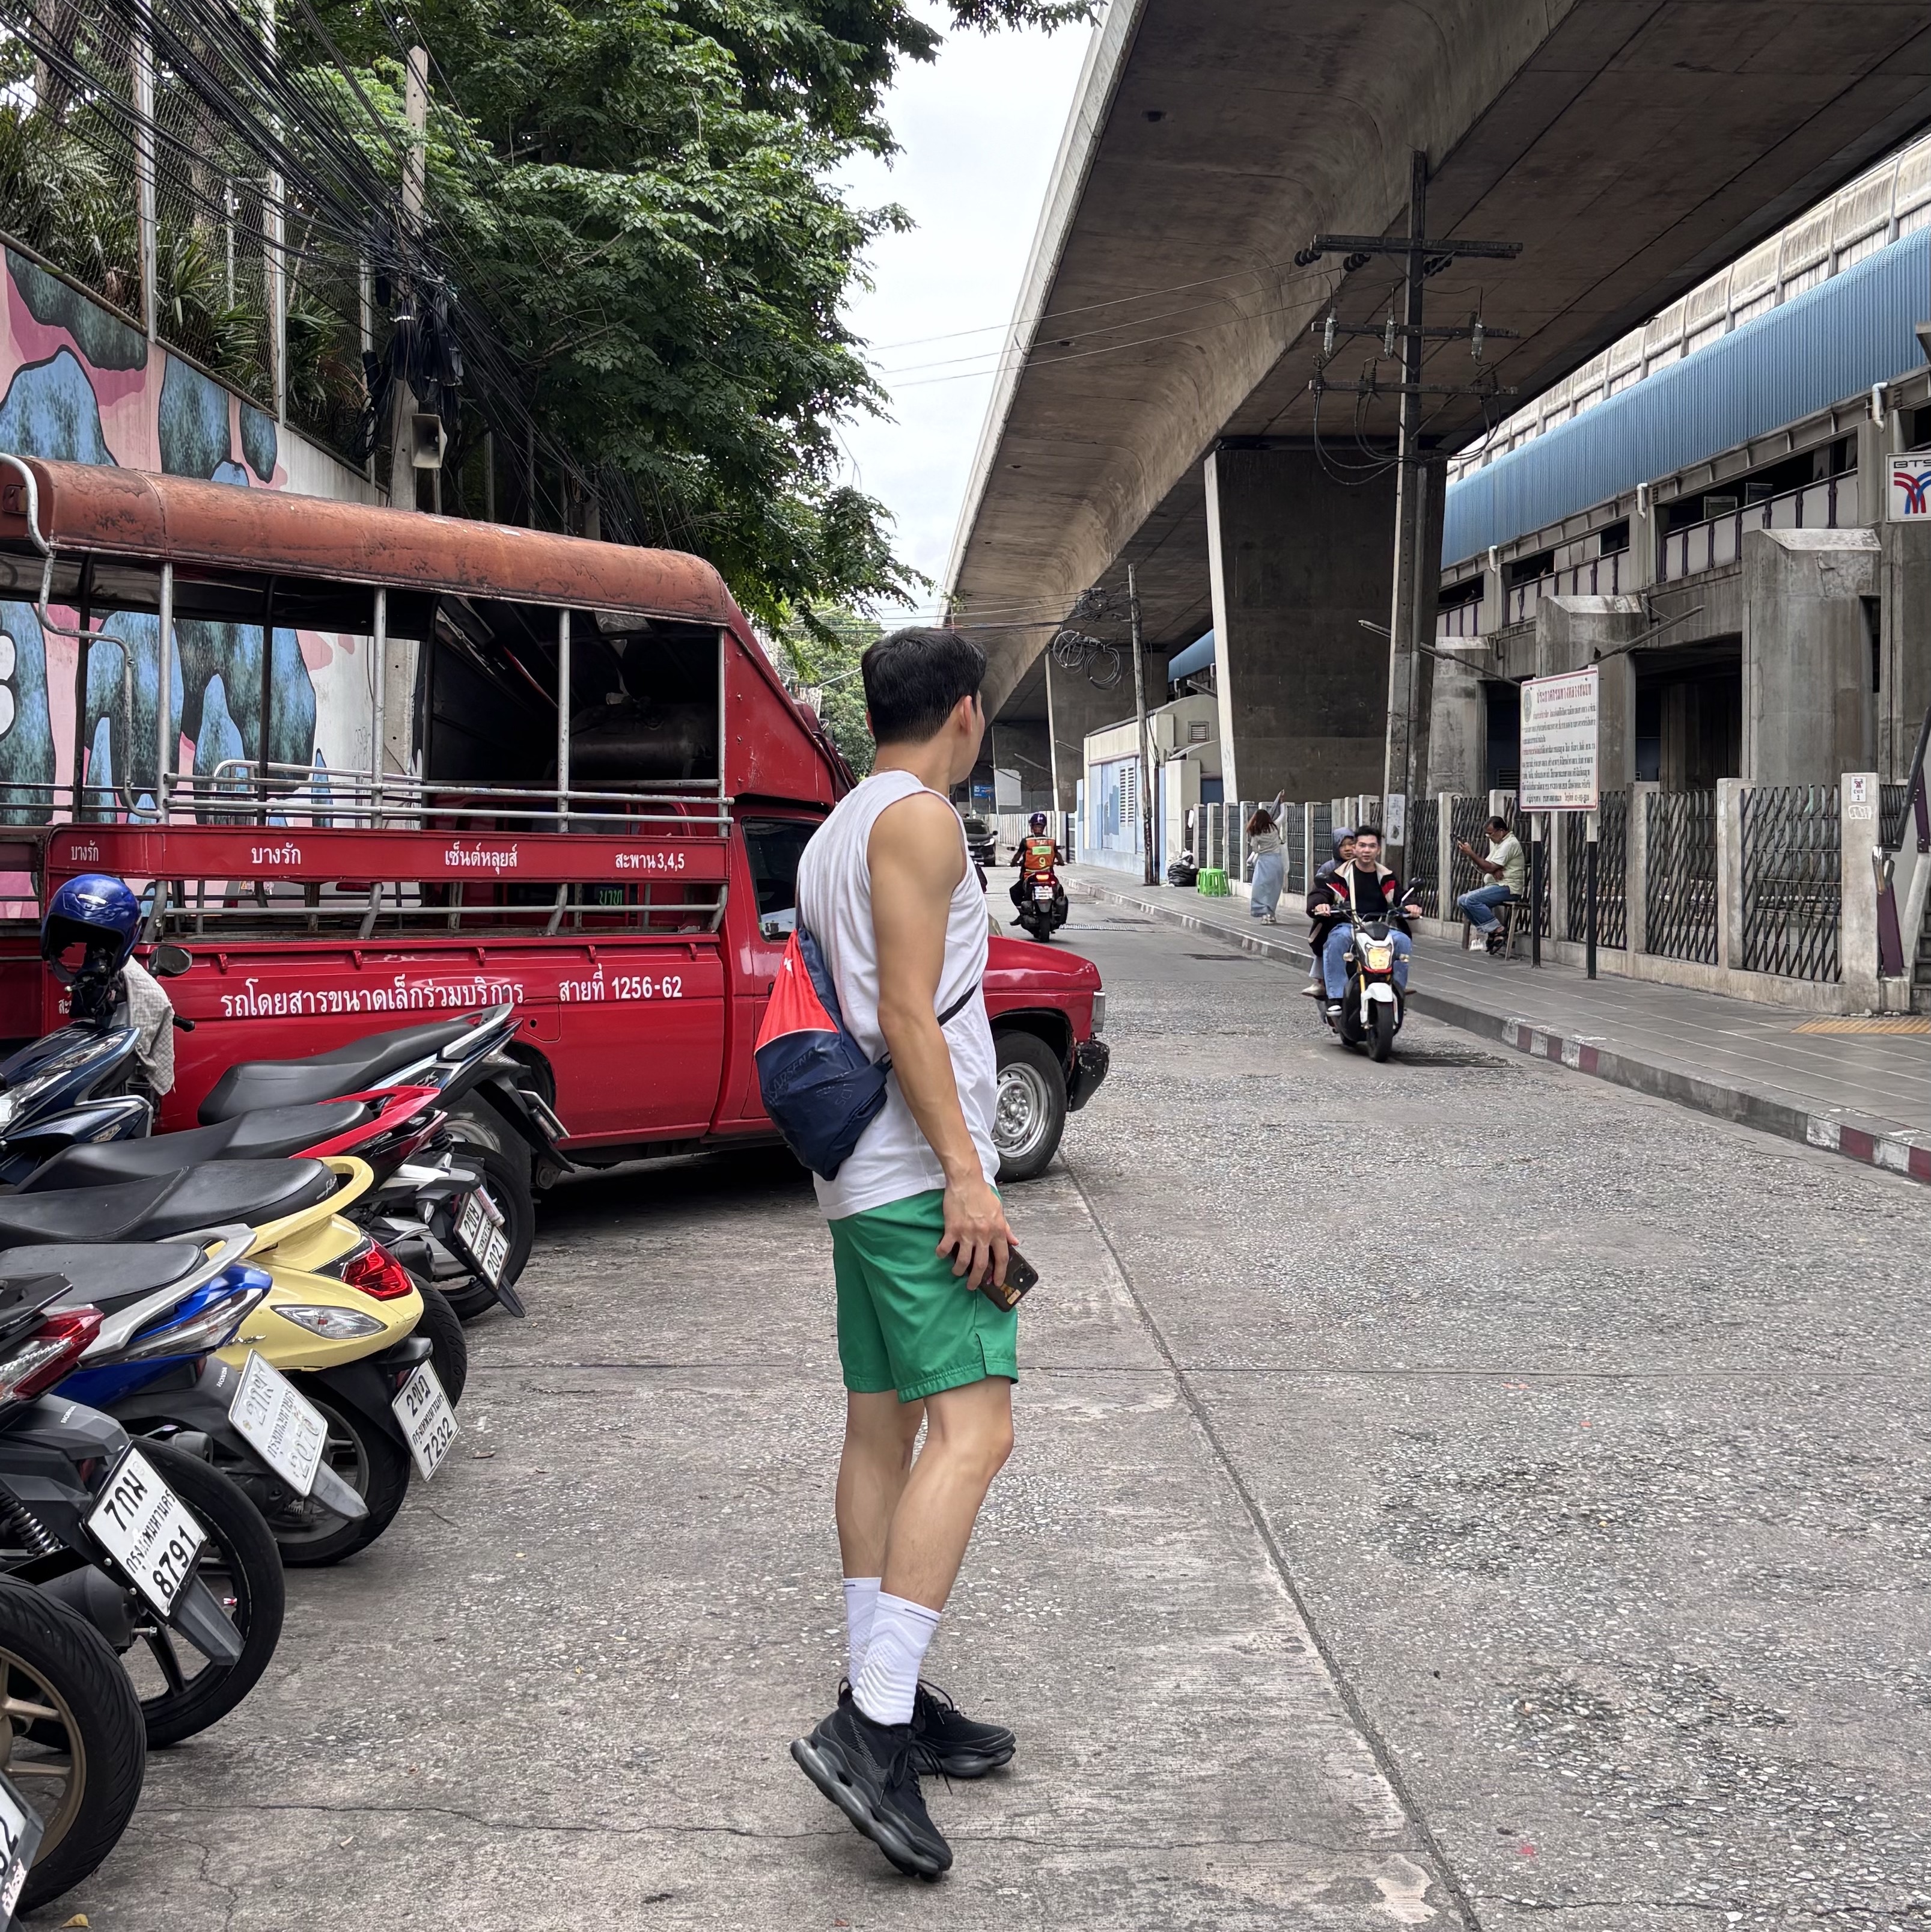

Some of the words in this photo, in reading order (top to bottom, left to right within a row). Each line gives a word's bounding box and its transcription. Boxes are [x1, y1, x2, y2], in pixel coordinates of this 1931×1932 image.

[1893, 459, 1931, 468] BTS
[71, 840, 99, 862] บางรัก
[251, 842, 301, 864] บางรัก
[445, 842, 518, 875] เซ็นต์หลุยส์
[221, 973, 523, 1017] รถโดยสารขนาดเล็กร่วมบริการ
[559, 963, 605, 1001] สายที่
[611, 976, 683, 1000] 1256-62
[487, 1235, 504, 1278] 2021
[423, 1417, 453, 1469] 7232
[103, 1469, 148, 1532] 7กม
[153, 1524, 197, 1599] 8791
